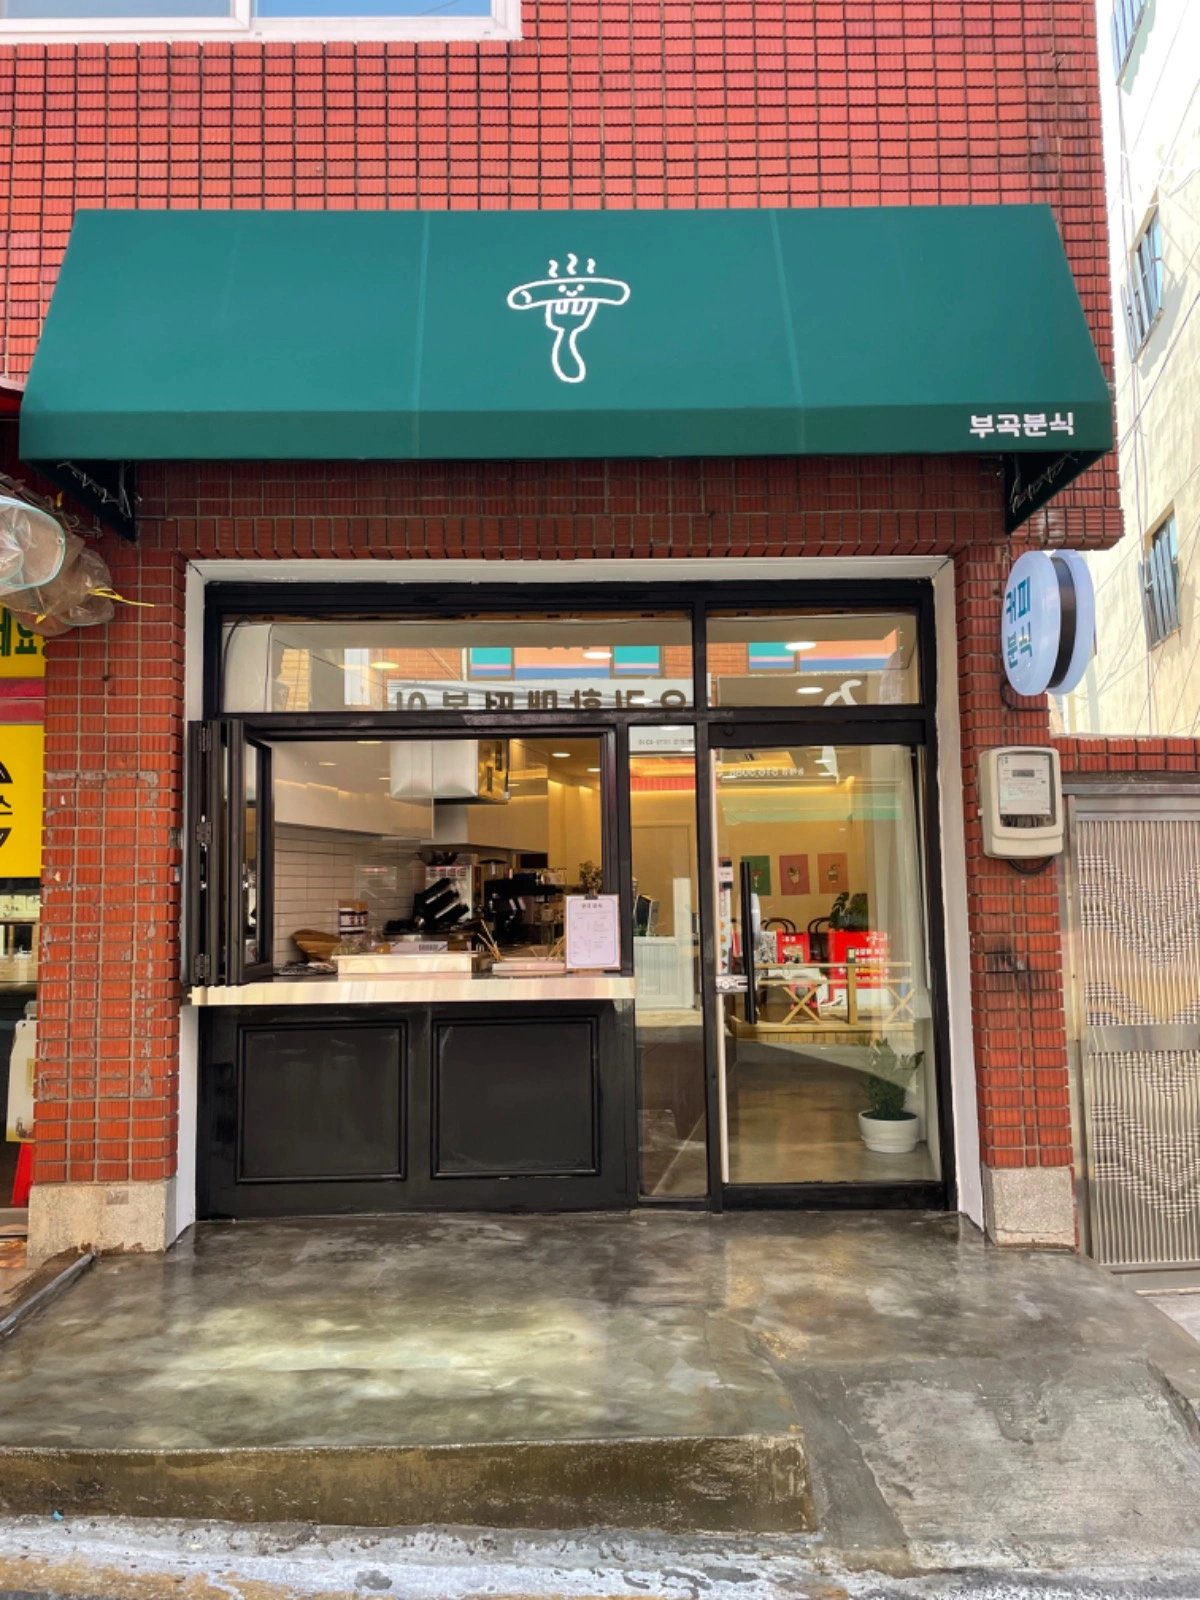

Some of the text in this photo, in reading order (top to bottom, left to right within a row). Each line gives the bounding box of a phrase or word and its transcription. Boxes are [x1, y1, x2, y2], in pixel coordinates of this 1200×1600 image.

[969, 412, 1074, 438] 부곡분식
[1006, 576, 1031, 625] 커피
[1008, 621, 1033, 669] 분식
